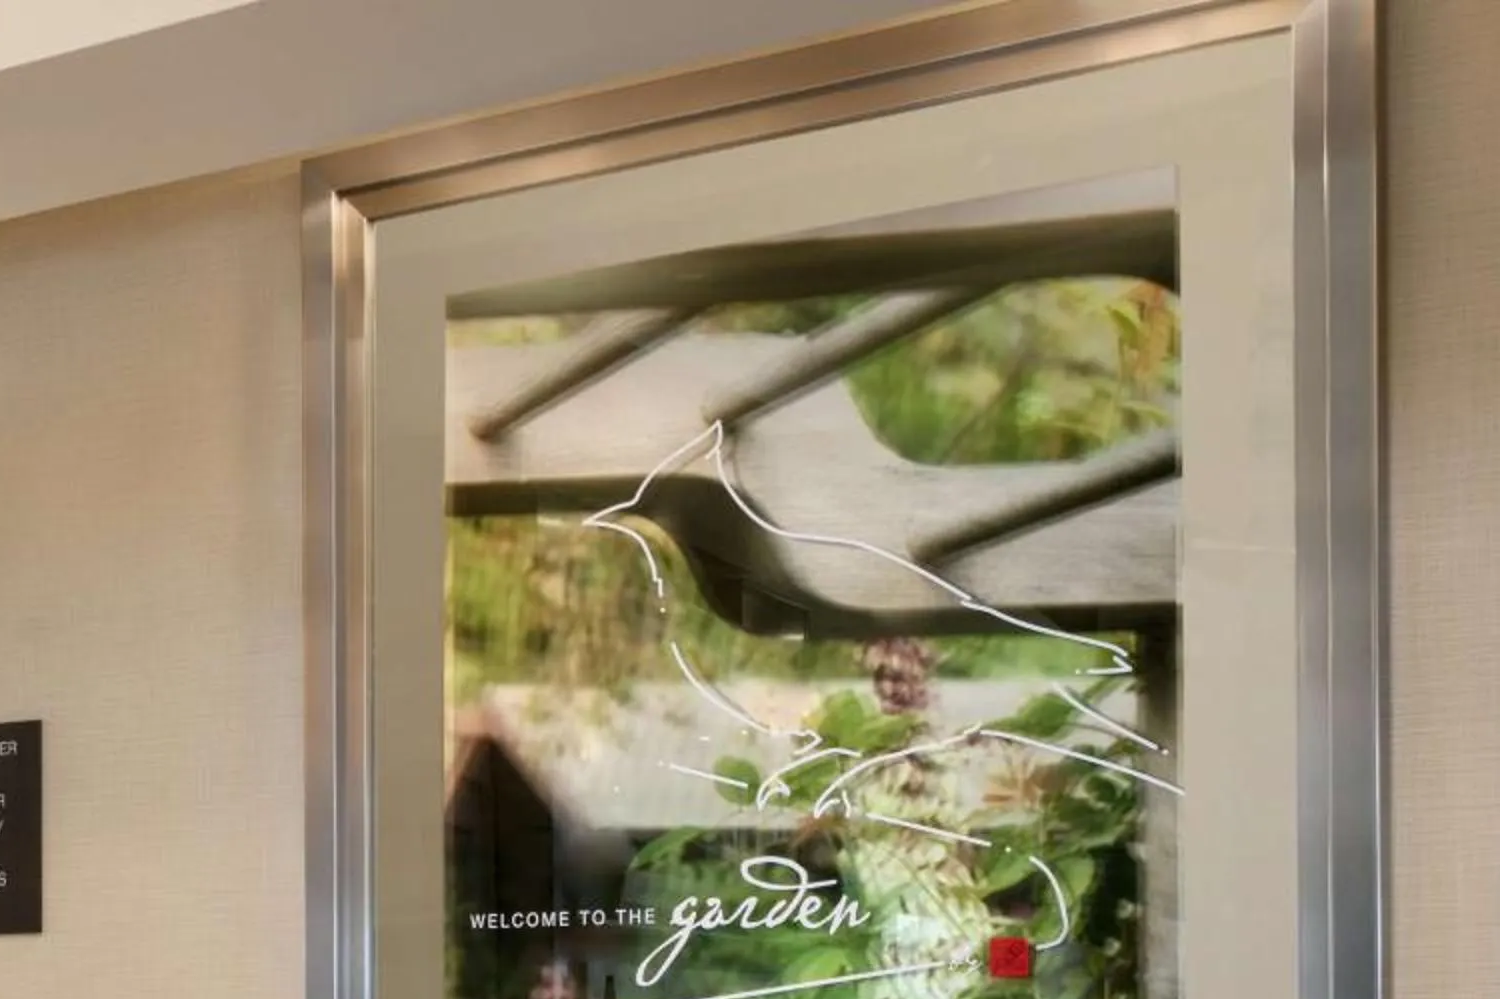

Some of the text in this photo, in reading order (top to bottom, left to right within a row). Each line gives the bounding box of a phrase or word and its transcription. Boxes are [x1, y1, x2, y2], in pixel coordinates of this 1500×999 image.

[469, 855, 871, 987] WELCOME TO THE garden
